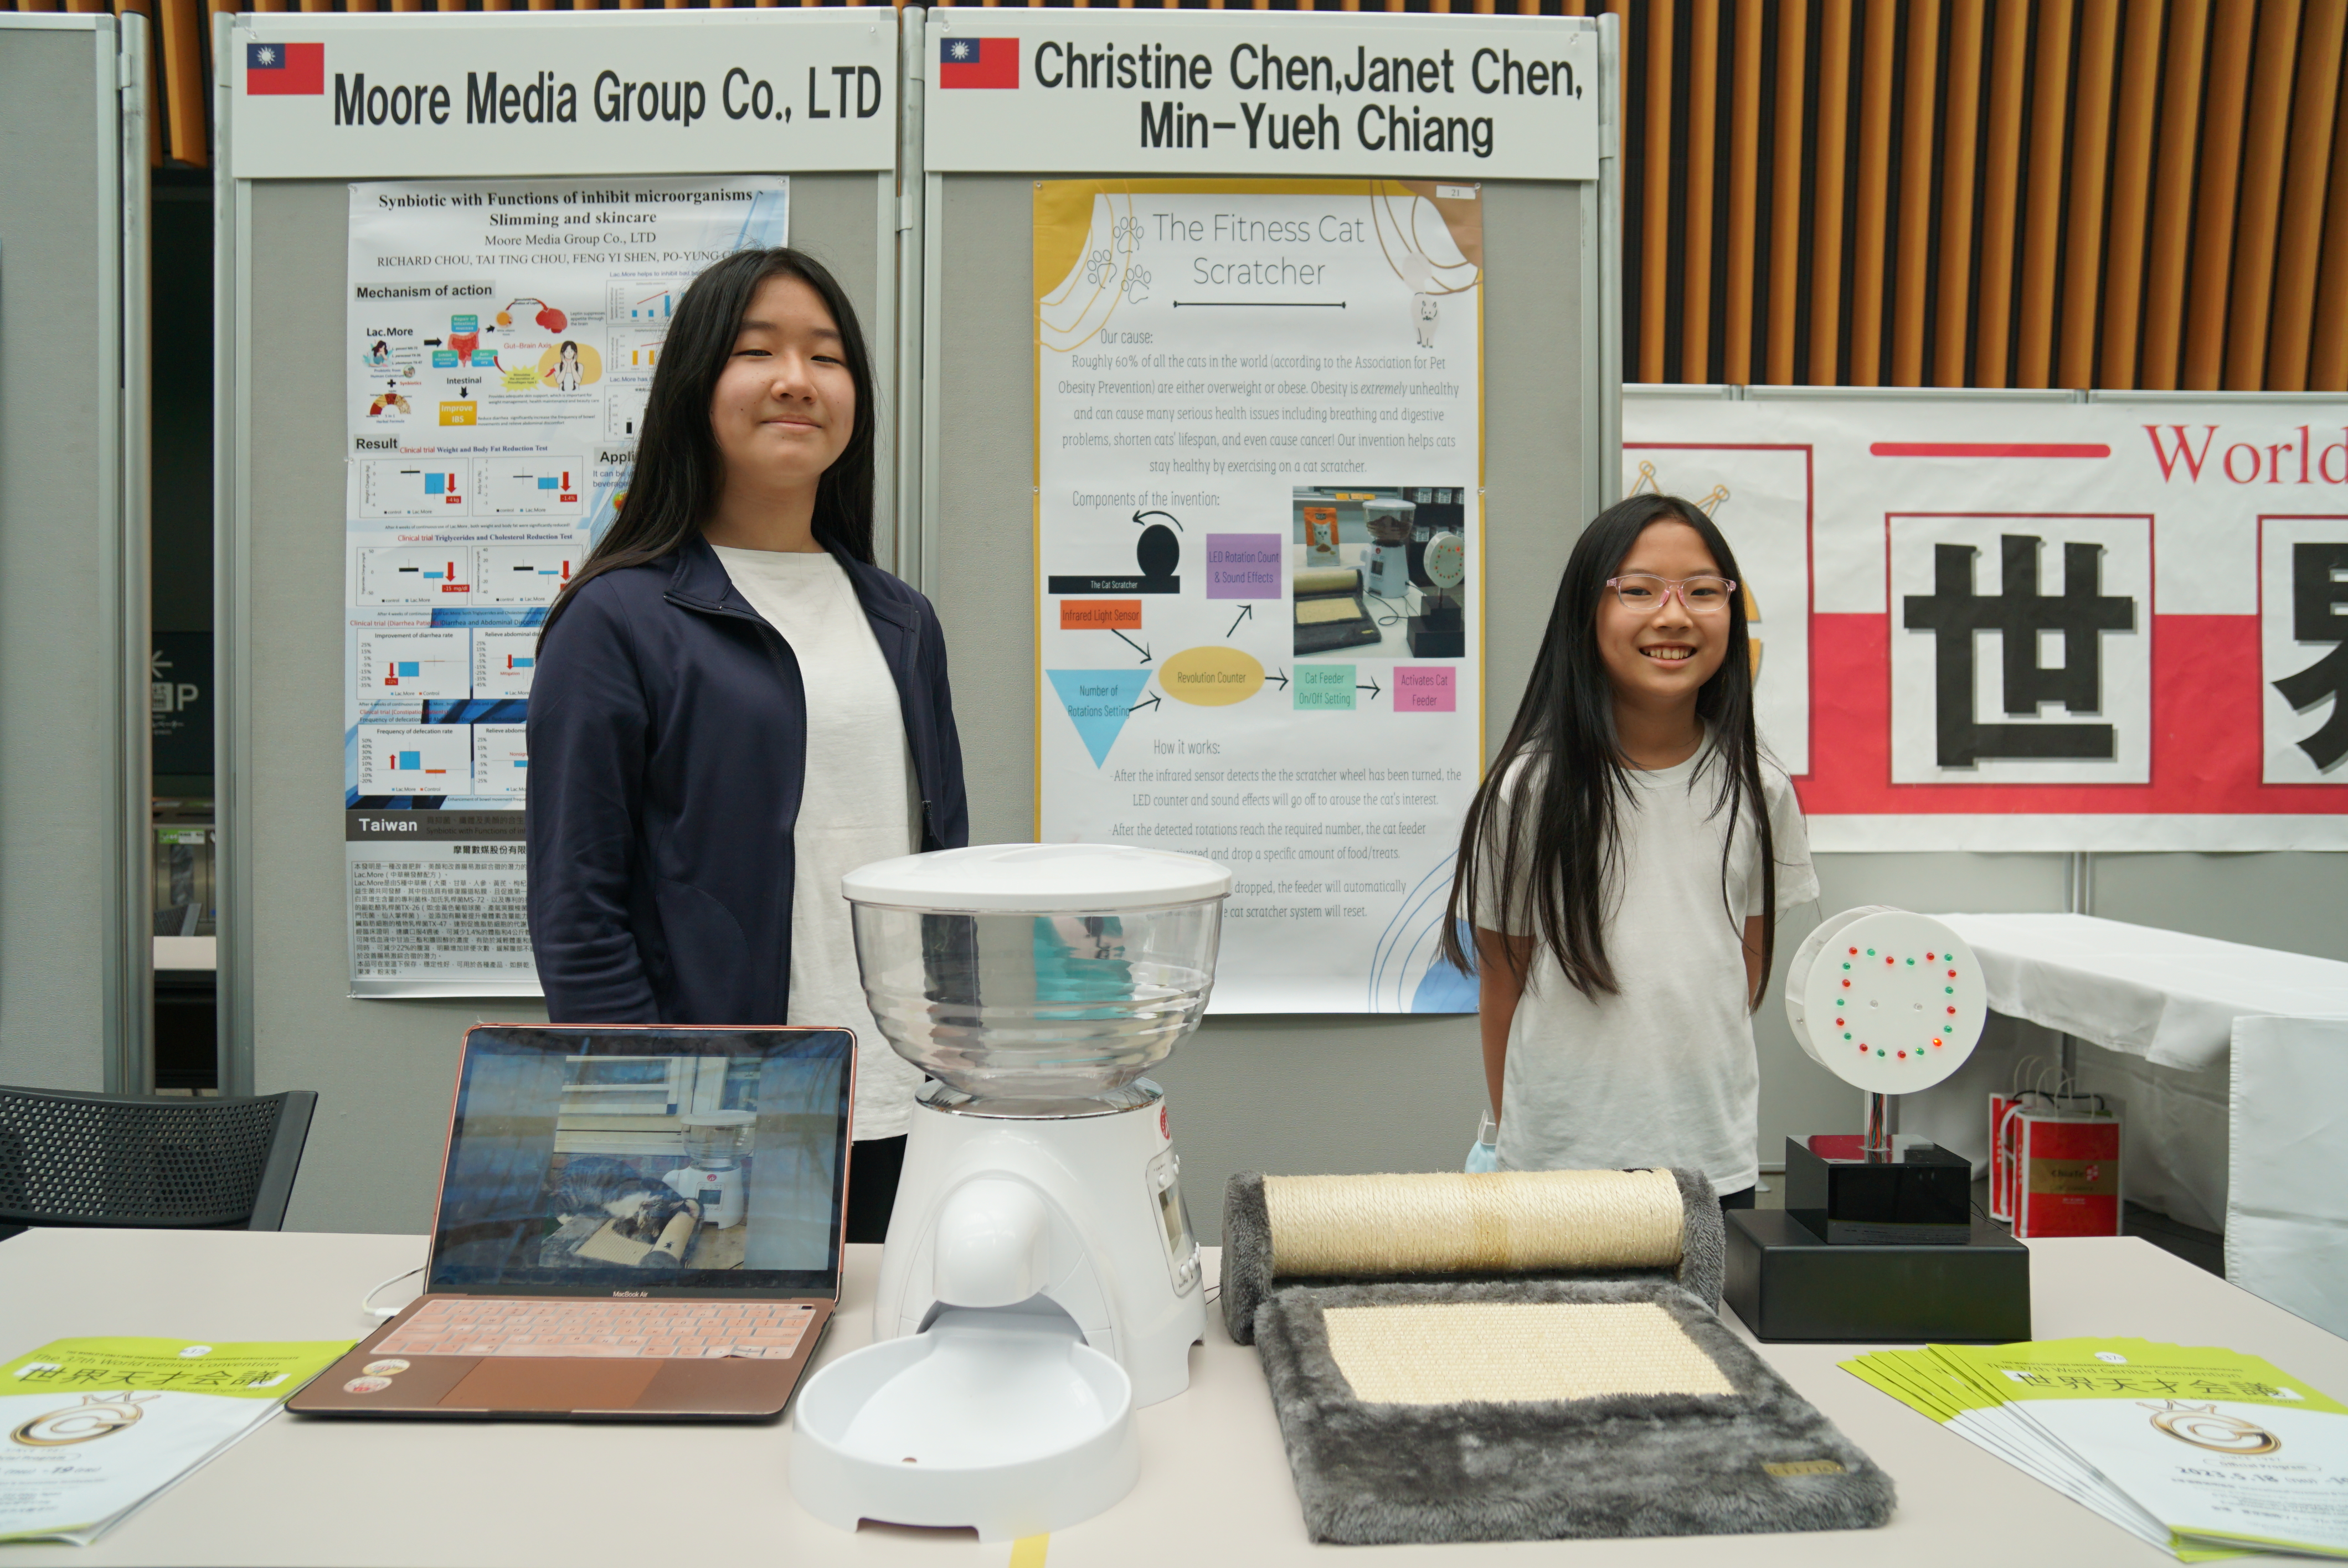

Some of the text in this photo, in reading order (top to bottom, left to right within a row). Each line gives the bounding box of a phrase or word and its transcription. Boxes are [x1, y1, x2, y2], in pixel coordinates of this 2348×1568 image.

[1035, 42, 1212, 89] Christine
[1472, 48, 1582, 100] Chen,
[335, 66, 881, 125] Moore Media Group Co., LTD
[1141, 101, 1493, 158] Min-Yueh Chiang
[379, 188, 752, 210] Synbiotic with Functions of inhibit microorganisms
[1451, 189, 1460, 197] 21
[490, 212, 656, 228] Slimming and skincare
[1152, 213, 1364, 242] The Fitness Cat
[486, 233, 656, 246] Moore Media Group Co., LTD
[378, 256, 431, 266] RICHARD
[435, 256, 472, 265] CHOU,
[476, 255, 495, 264] TAI
[499, 255, 528, 264] TING
[532, 254, 569, 264] CHOU,
[574, 254, 604, 263] FENG
[609, 253, 620, 262] YI
[625, 252, 659, 262] SHEN,
[664, 250, 719, 263] PO-YUNG
[1194, 256, 1325, 285] Scratcher
[357, 285, 492, 298] Mechanism of action
[367, 328, 413, 336] Lac.More
[1101, 329, 1152, 344] Our cause:
[1072, 354, 1445, 371] Roughly 60% of all the cats in the world (according to the Association for Pet
[446, 376, 482, 385] Intestinal
[441, 405, 473, 413] Improve
[451, 415, 465, 424] IBS
[357, 438, 397, 449] Result
[2141, 424, 2348, 484] World
[1073, 491, 1219, 510] Components of the invention:
[1209, 551, 1279, 563] LED Rotation Count
[1215, 571, 1273, 583] & Sound Effects
[1063, 610, 1140, 623] Infrared Light Sensor
[1178, 672, 1246, 683] Revolution Counter
[1306, 672, 1344, 684] Cat Feeder
[1402, 674, 1448, 685] Activates Cat
[1080, 685, 1118, 697] Number of
[1299, 693, 1350, 706] On/Off Setting
[1413, 694, 1437, 706] Feeder
[1068, 705, 1130, 720] Rotations Setting
[1155, 739, 1220, 755] How it works:
[359, 818, 417, 831] Taiwan
[1235, 880, 1406, 896] dropped, the feeder will automatically
[1230, 905, 1367, 920] cat scratcher system will reset.
